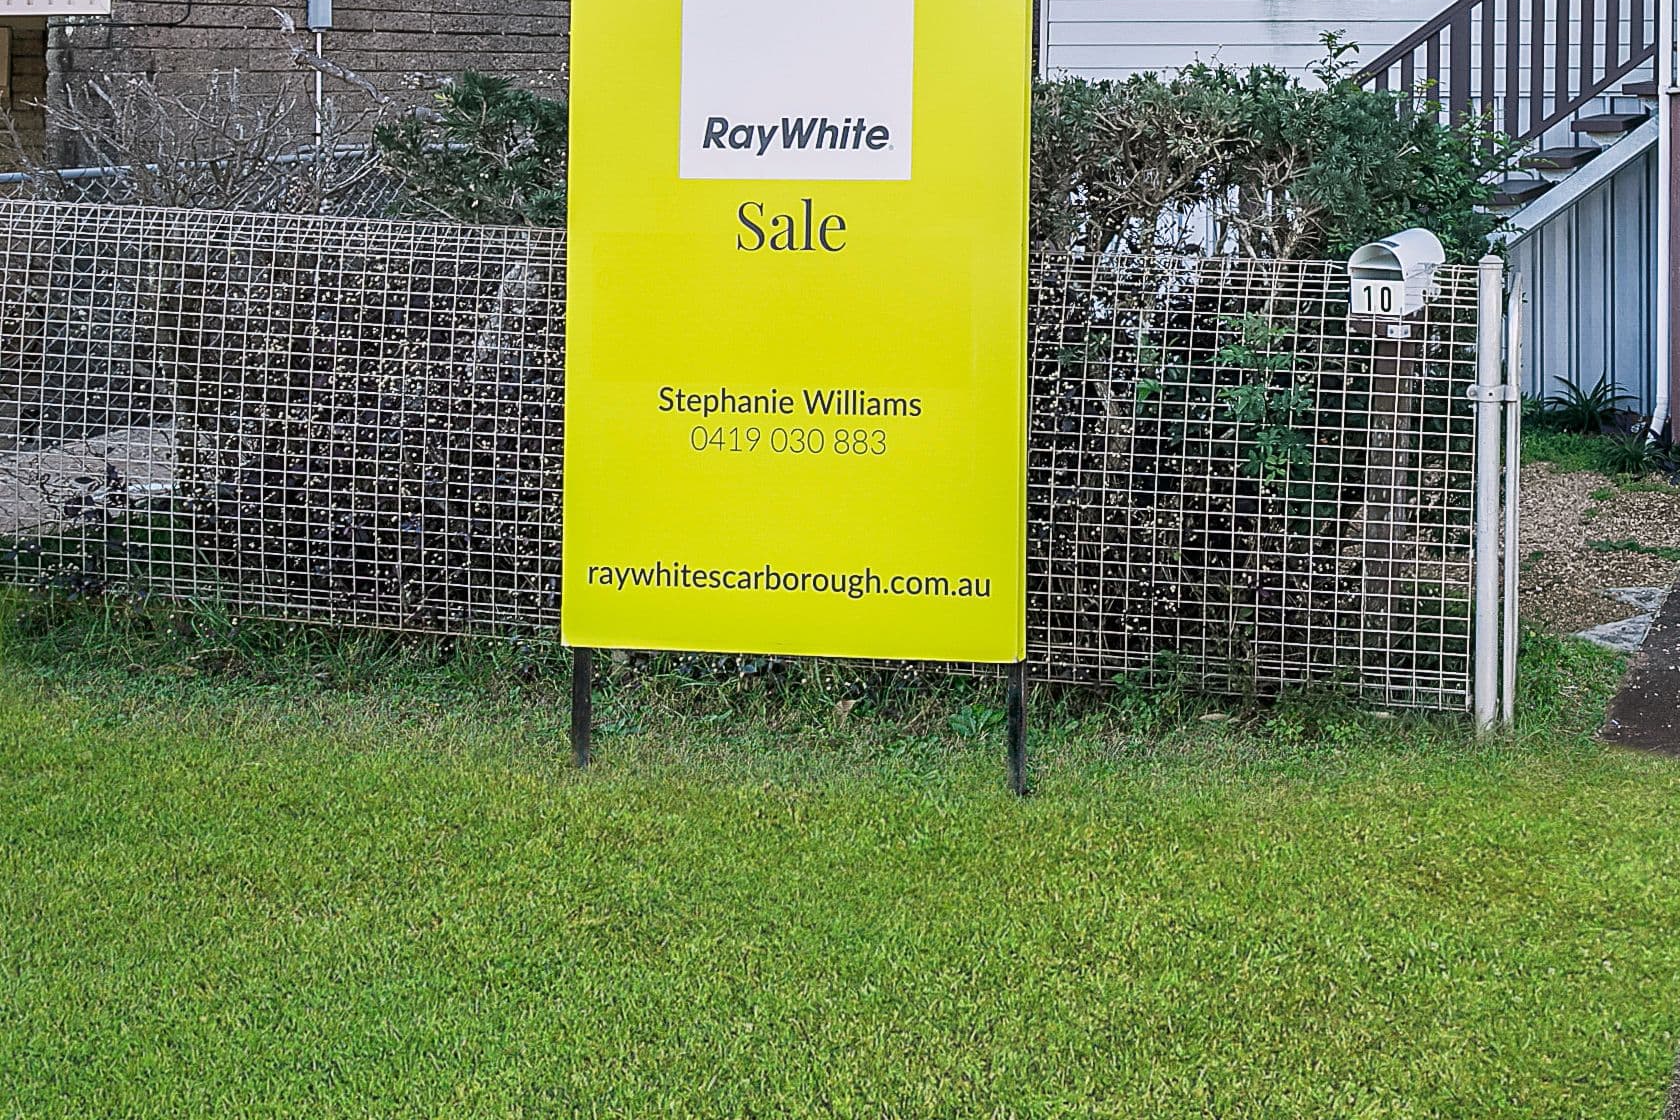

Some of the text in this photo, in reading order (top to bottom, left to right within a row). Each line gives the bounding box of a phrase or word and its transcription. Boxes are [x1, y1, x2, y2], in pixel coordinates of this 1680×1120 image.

[737, 198, 847, 252] Sale
[1363, 285, 1392, 313] 10
[658, 387, 922, 417] Stephanie Williams
[691, 426, 887, 455] 0419 030 883
[588, 561, 991, 599] raywhitescarborough.com.au
